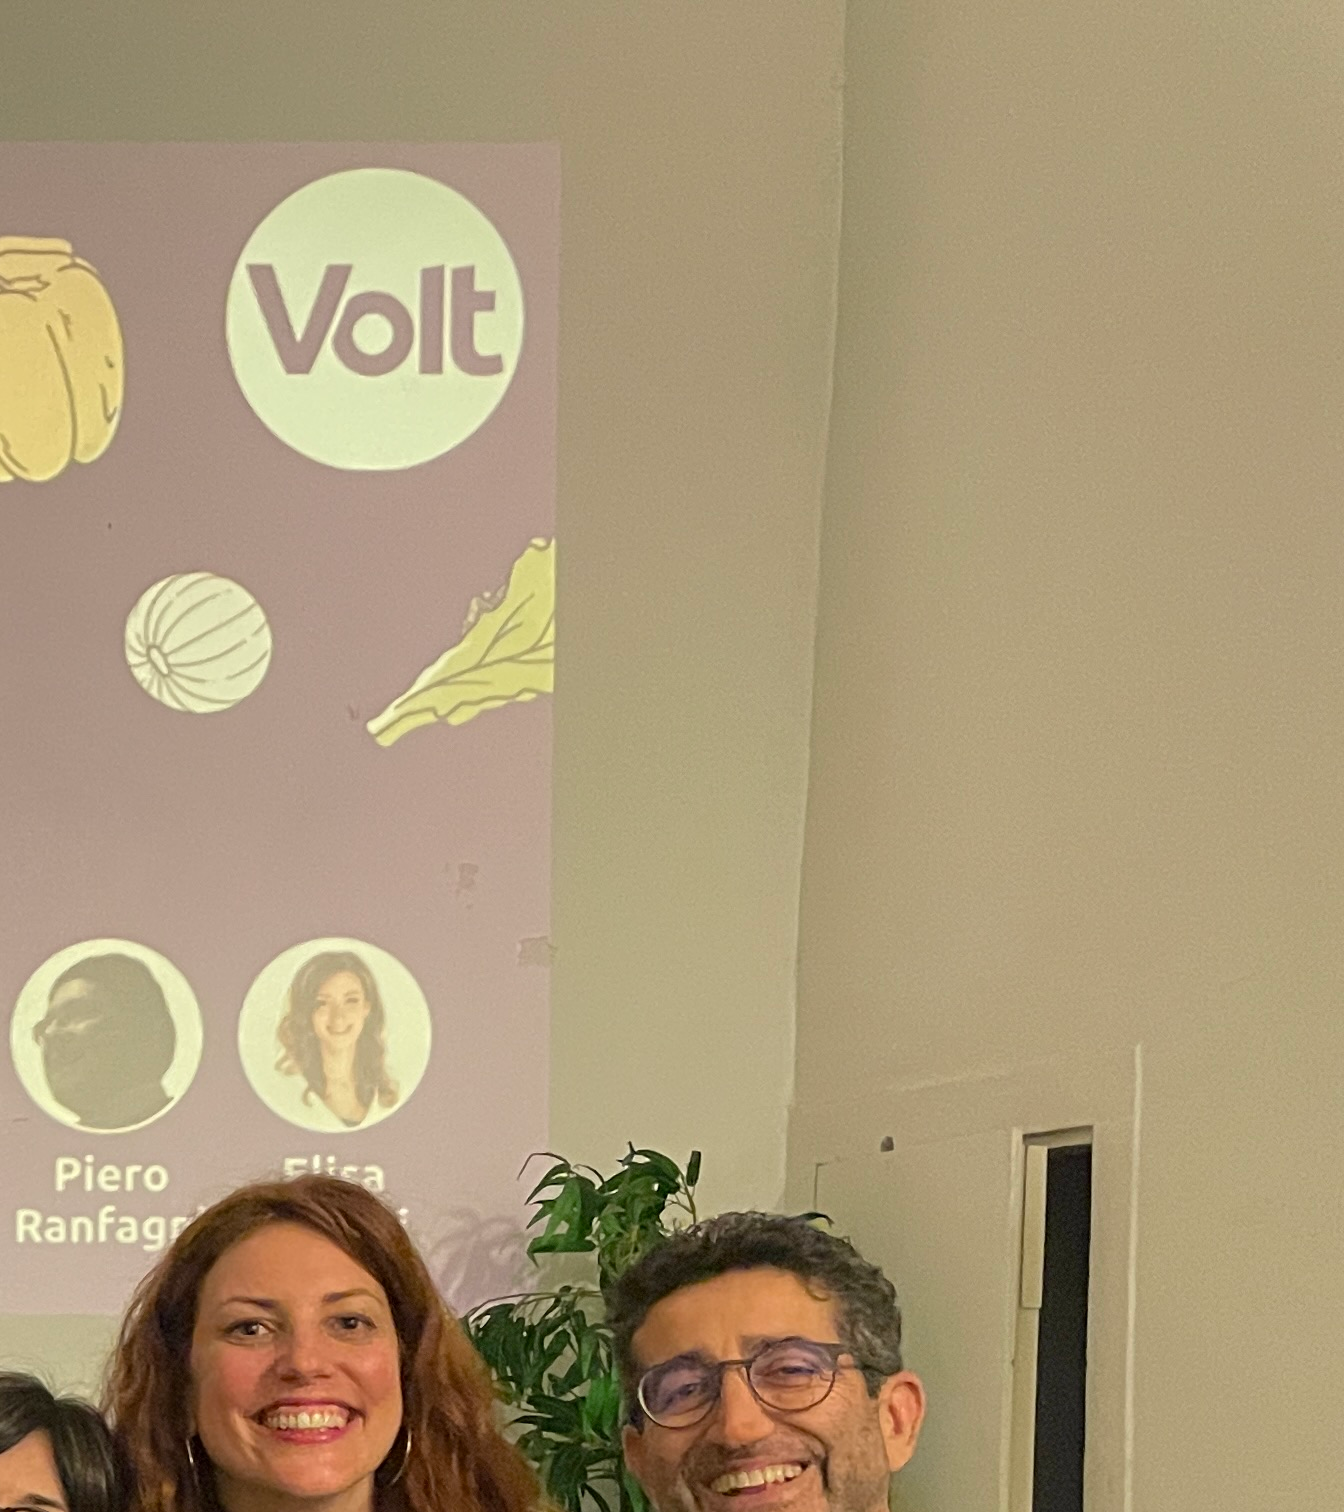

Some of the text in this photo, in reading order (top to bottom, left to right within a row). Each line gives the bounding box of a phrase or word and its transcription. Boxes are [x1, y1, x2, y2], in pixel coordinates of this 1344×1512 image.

[246, 264, 505, 378] Volt
[56, 1155, 170, 1193] Piero
[15, 1206, 206, 1252] Ranfag
